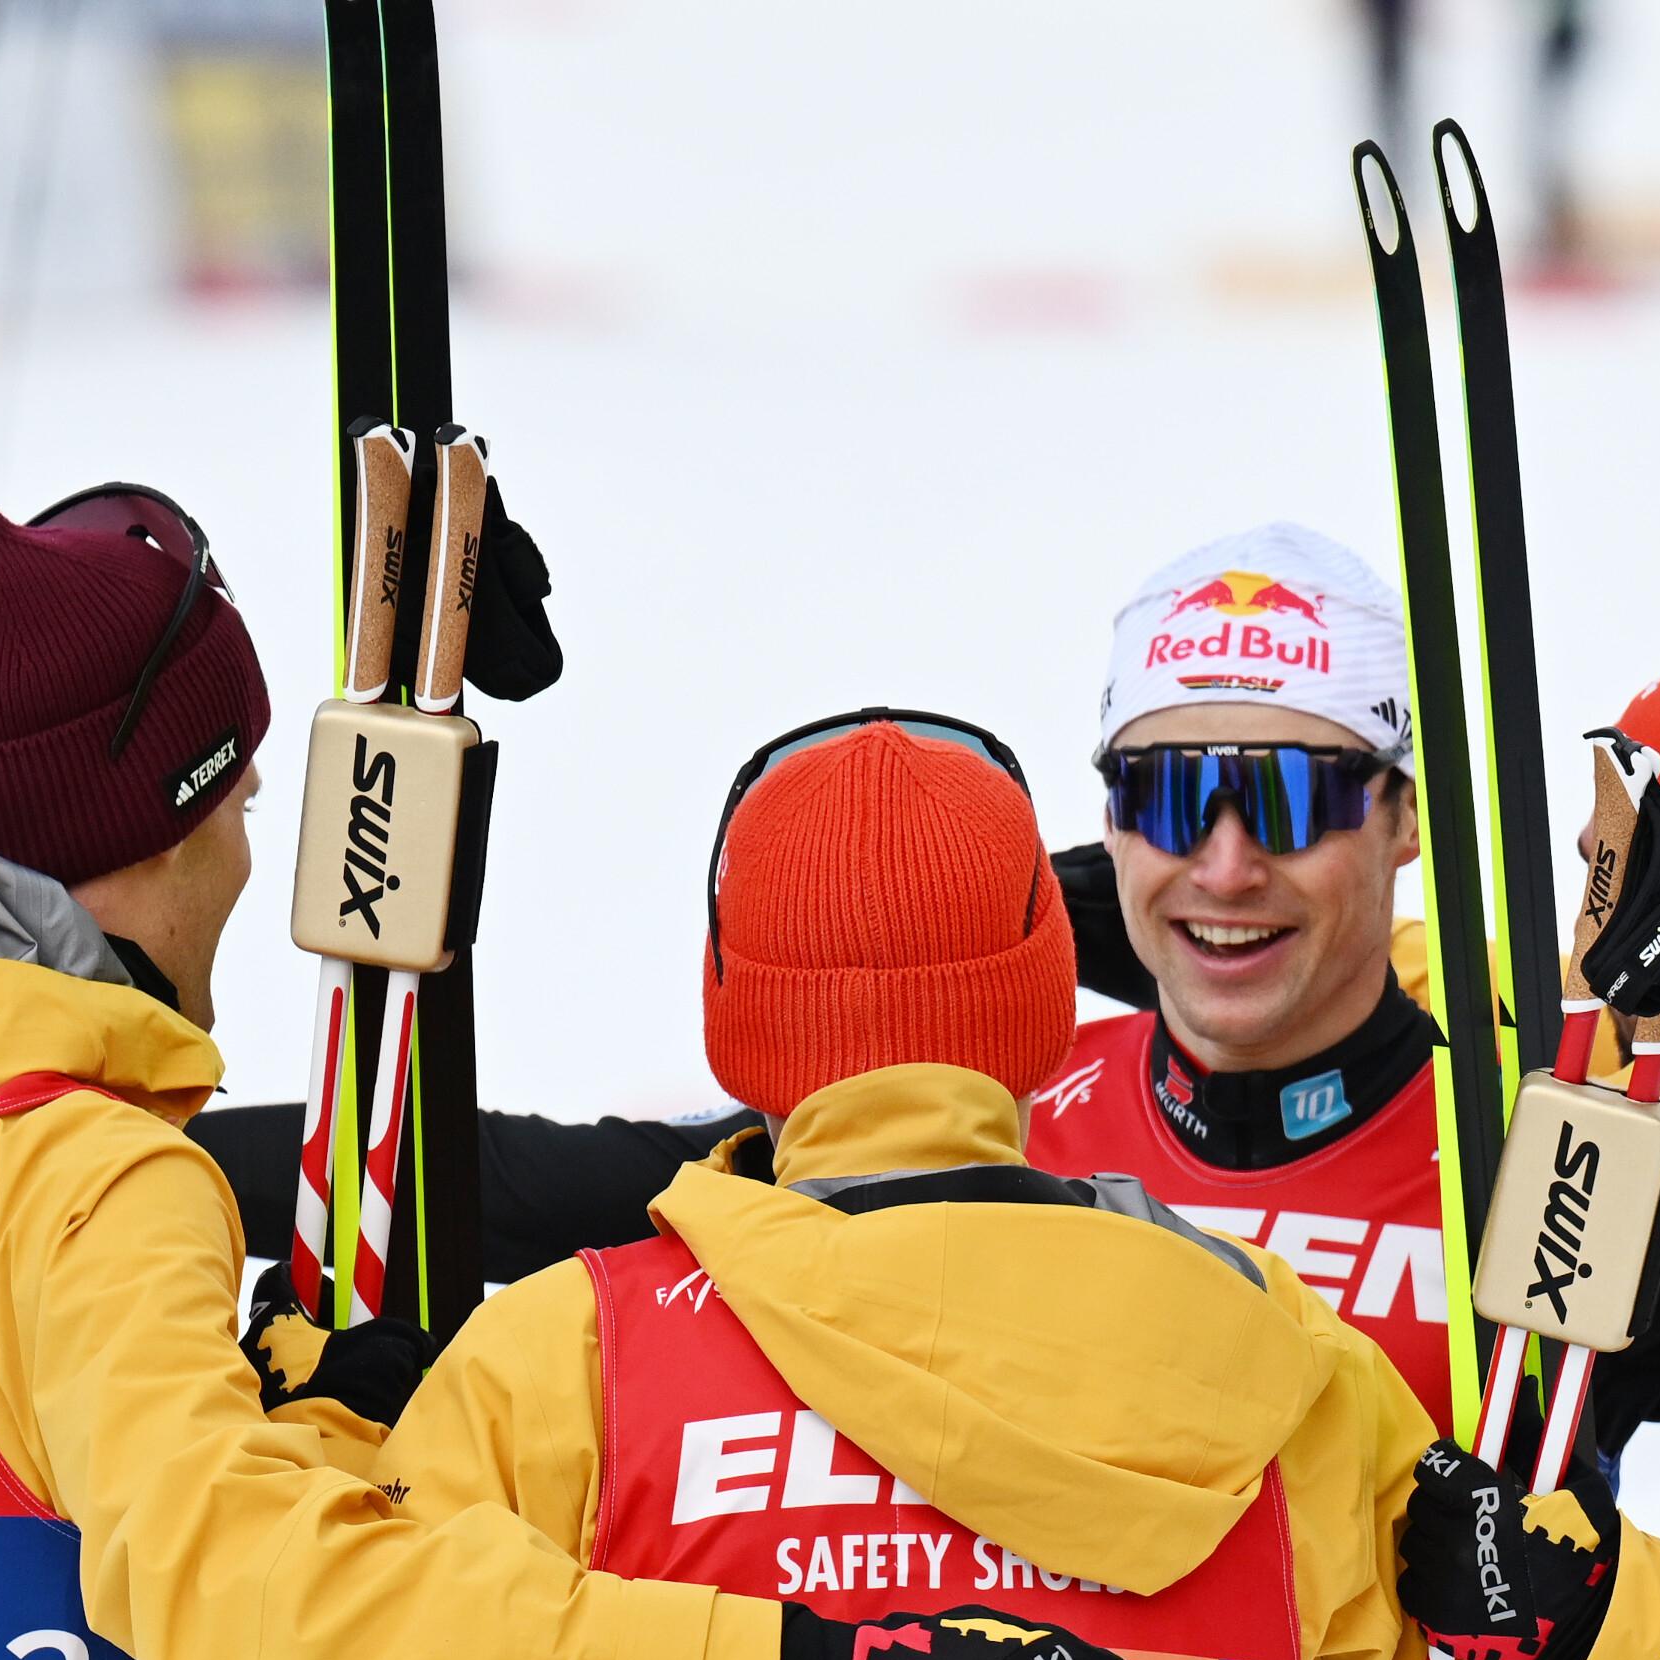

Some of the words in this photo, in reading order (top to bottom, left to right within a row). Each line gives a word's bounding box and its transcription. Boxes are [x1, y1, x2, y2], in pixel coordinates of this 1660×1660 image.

[1145, 622, 1231, 670] Red
[1240, 624, 1331, 674] Bull
[190, 736, 237, 792] TERREX
[776, 1533, 953, 1595] SAFETY
